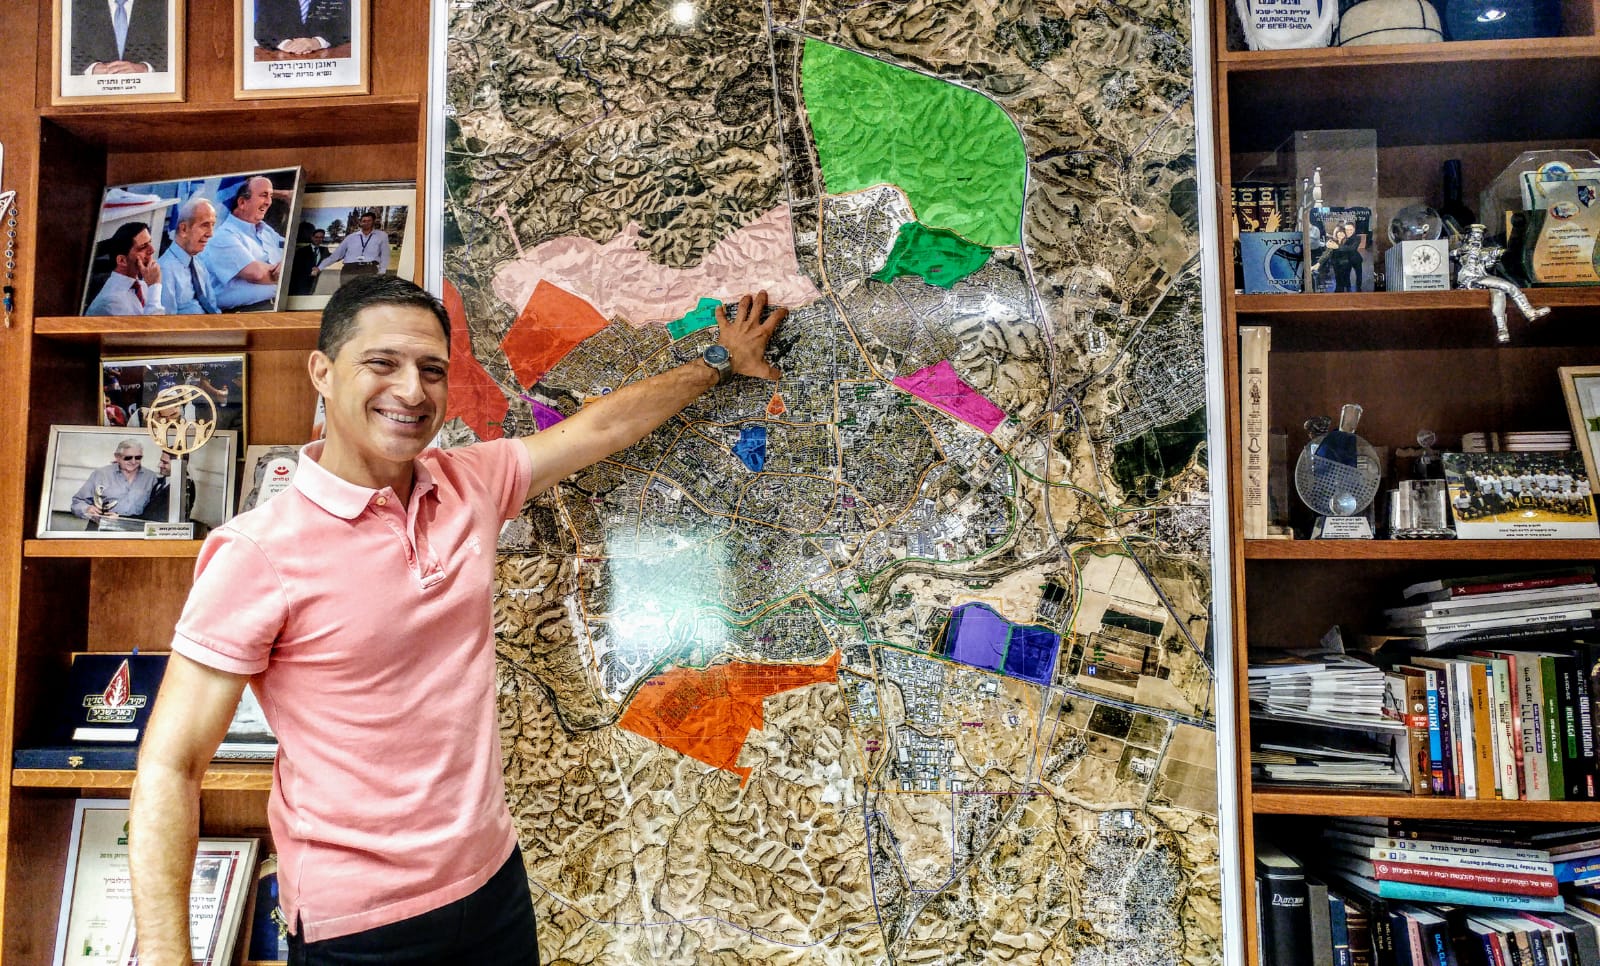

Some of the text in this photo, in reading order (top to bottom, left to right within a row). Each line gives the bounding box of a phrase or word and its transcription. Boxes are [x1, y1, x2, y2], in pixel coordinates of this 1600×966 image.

[1428, 695, 1439, 731] טאיוואן
[1522, 704, 1534, 753] דרך חיים
[1519, 863, 1536, 871] Friday
